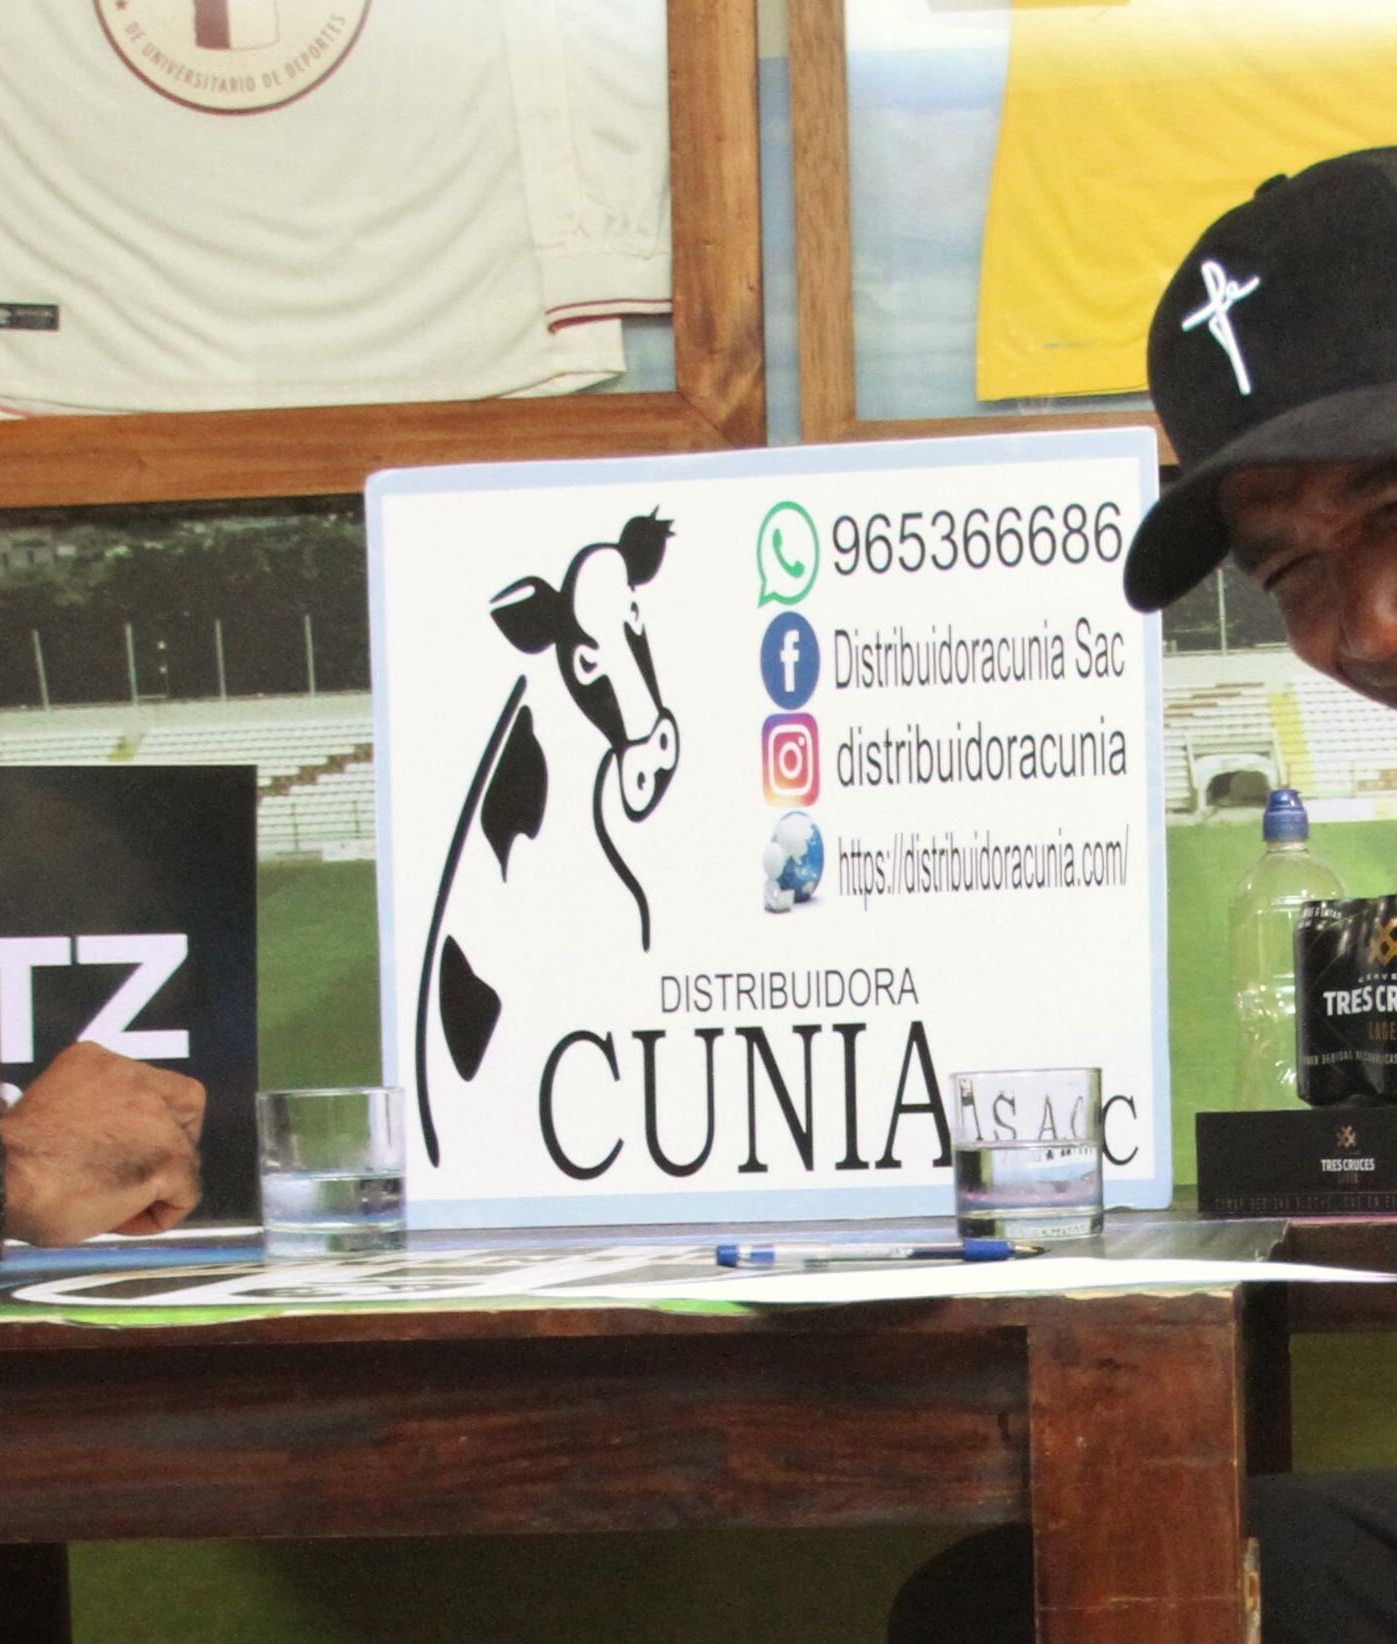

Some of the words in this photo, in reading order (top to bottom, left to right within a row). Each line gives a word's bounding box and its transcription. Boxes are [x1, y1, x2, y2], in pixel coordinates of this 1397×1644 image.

[142, 43, 256, 94] UNIVERSITARIO
[264, 69, 282, 90] DE
[286, 13, 347, 78] DEPORTES
[832, 501, 1123, 576] 965366686
[834, 619, 1065, 689] Distribuidoracunia
[1075, 616, 1125, 678] Sac
[837, 715, 1127, 788] distribuidoracunia
[838, 823, 1130, 912] https://distribuidoracunia.com/
[661, 967, 919, 1013] DISTRIBUIDORA
[1323, 985, 1373, 1016] TRES
[538, 1020, 952, 1181] CUNIA
[1320, 1158, 1342, 1172] TRES
[1343, 1157, 1376, 1171] CRUCES
